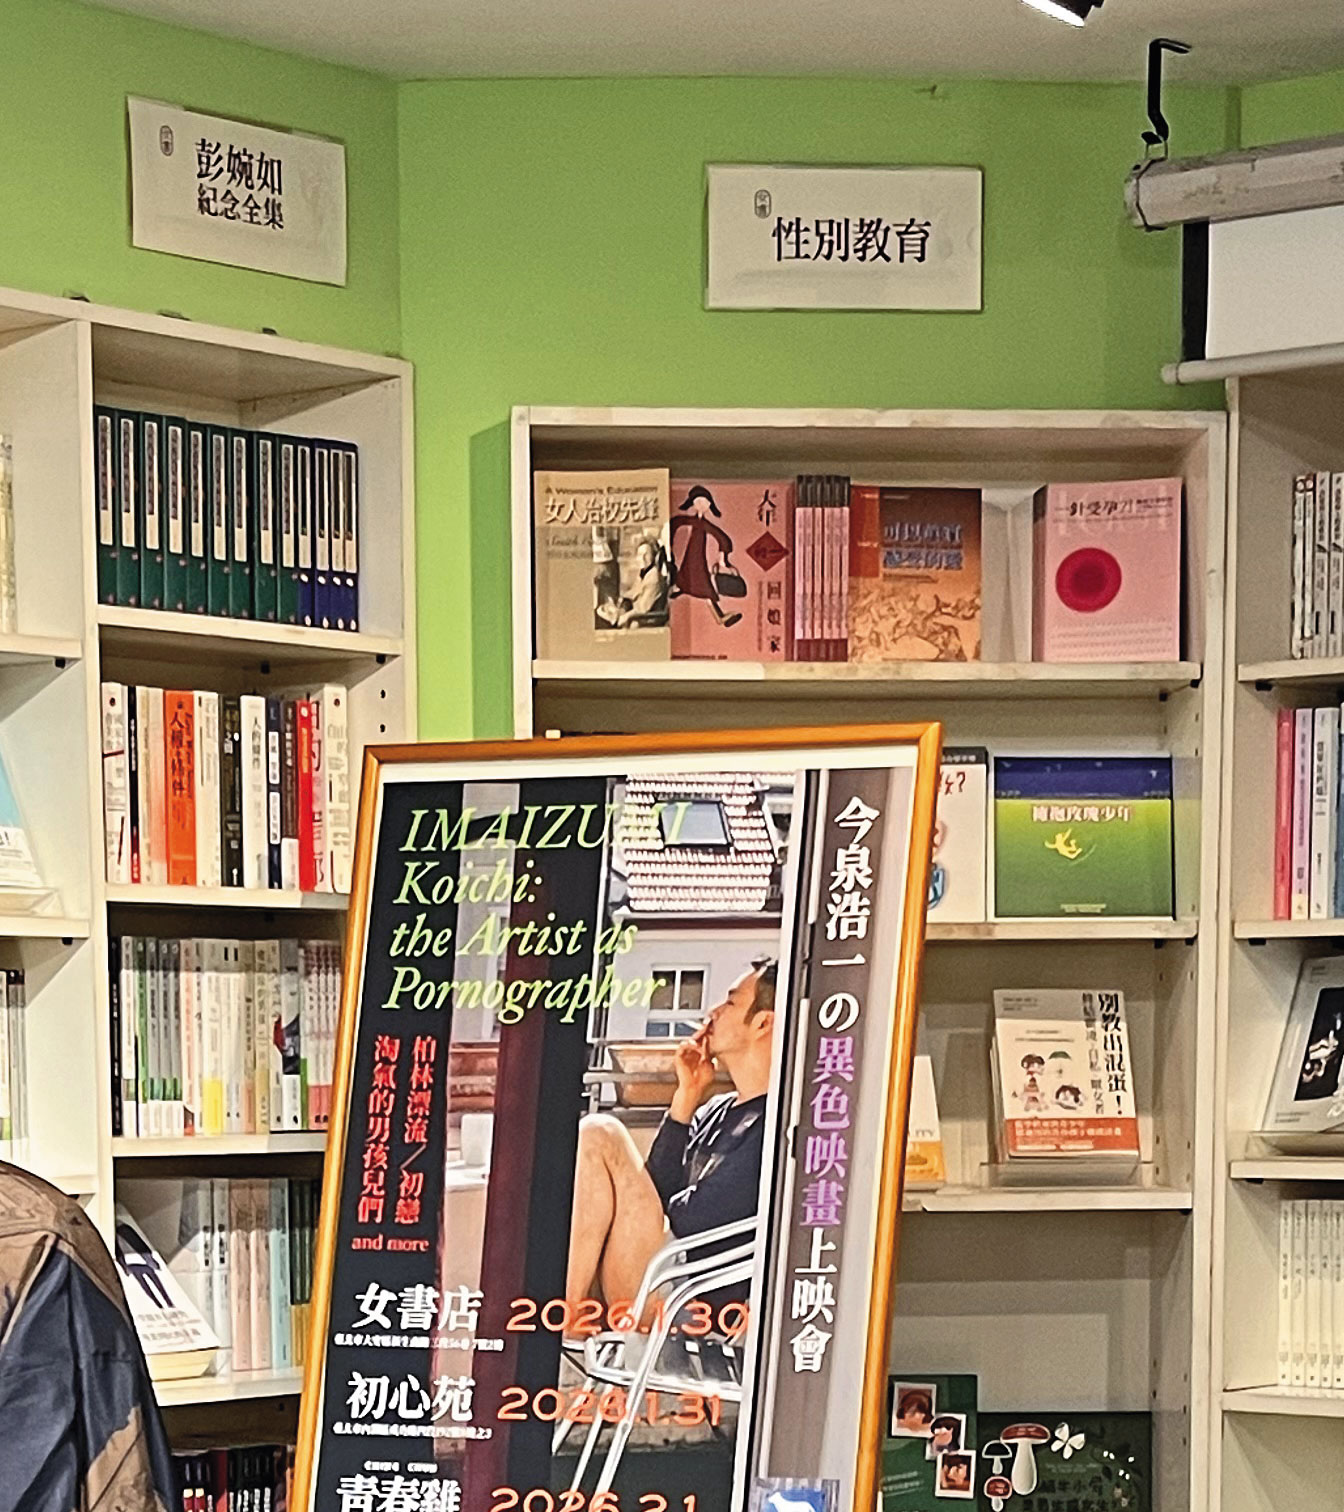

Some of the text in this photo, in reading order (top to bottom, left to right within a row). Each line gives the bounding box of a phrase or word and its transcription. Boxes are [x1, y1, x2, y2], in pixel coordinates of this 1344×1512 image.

[194, 137, 284, 196] 彭婉如
[197, 182, 285, 231] 紀念全集
[771, 216, 932, 264] 性別教育
[392, 861, 543, 906] Koichi:
[389, 913, 639, 958] the Artist as
[382, 965, 668, 1025] Pornographer
[788, 796, 881, 1374] 今泉浩一の異色映畫上映會
[357, 1034, 401, 1225] 淘氣的男孩兒們
[351, 1233, 429, 1252] and more
[351, 1282, 484, 1332] 女書店
[506, 1297, 751, 1337] 2026.1.30
[345, 1371, 477, 1422] 初心苑
[497, 1387, 722, 1427] 2026.1.31
